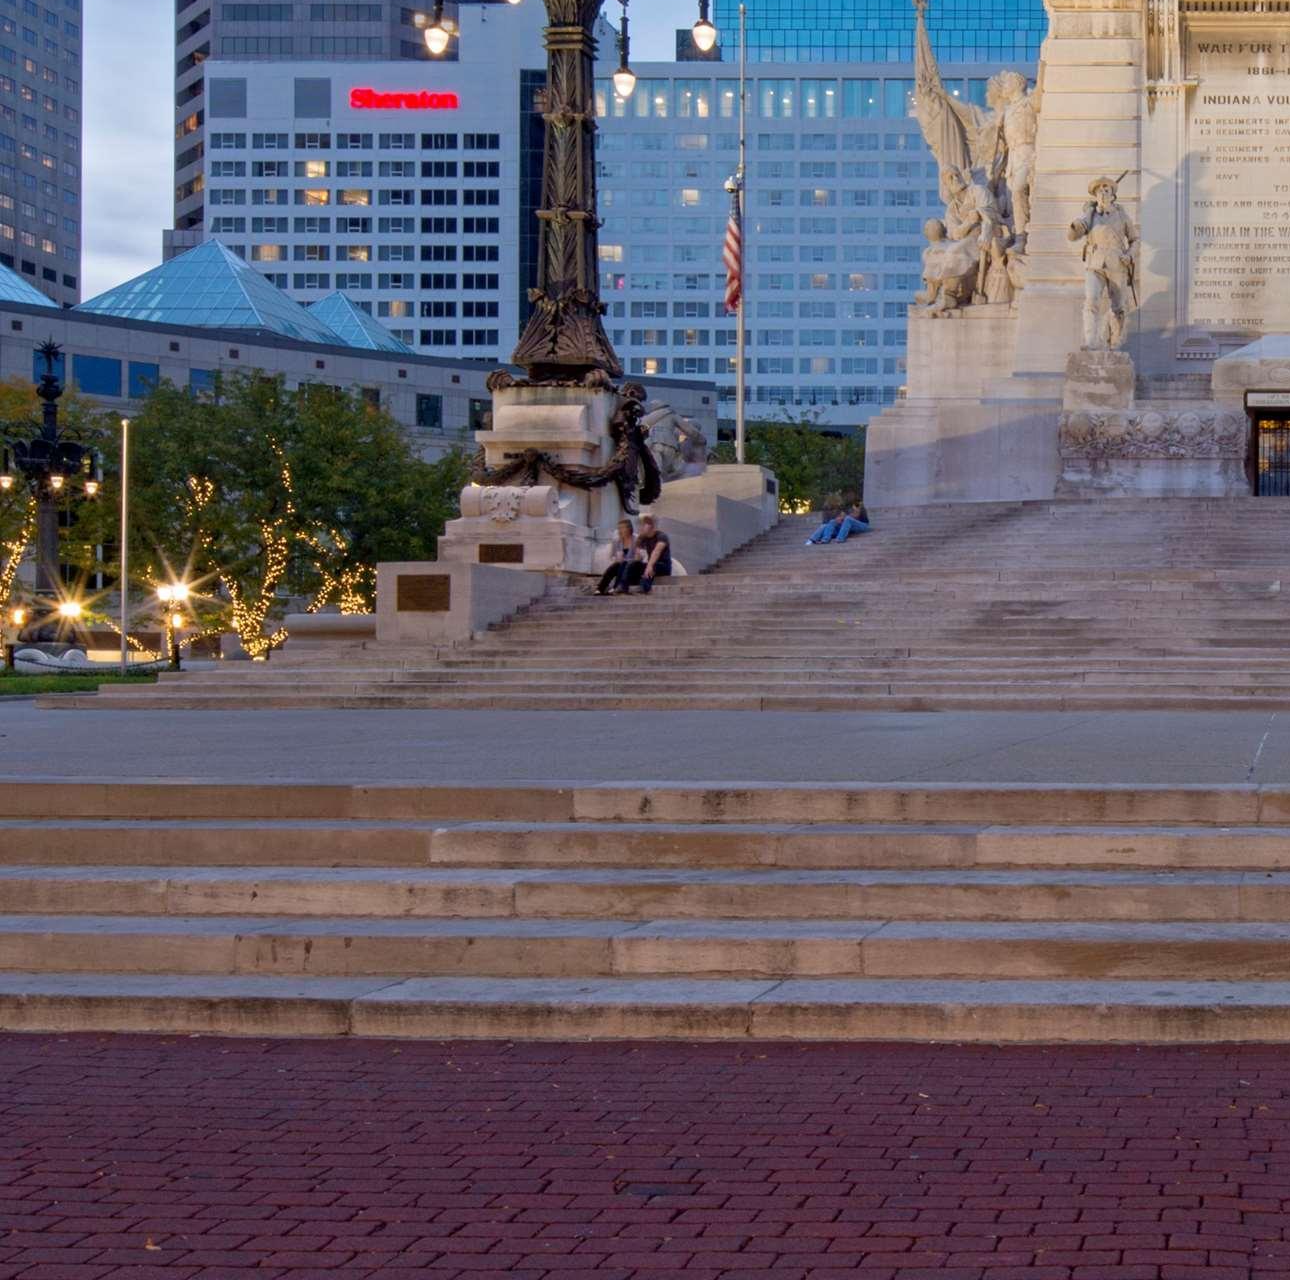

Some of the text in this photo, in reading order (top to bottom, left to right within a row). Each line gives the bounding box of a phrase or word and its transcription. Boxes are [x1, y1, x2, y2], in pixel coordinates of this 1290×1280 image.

[1198, 43, 1232, 54] WAR
[1239, 43, 1272, 54] FOR
[349, 88, 460, 110] Sheraton
[1203, 95, 1262, 105] INDIANA
[1215, 117, 1270, 125] REGIMENTS
[1215, 128, 1270, 136] REGIMENTS
[1215, 145, 1264, 153] REGIMENT
[1215, 156, 1270, 164] COMPANIES
[1215, 173, 1240, 181] NAVY
[1194, 226, 1236, 238] INDIANA
[1239, 226, 1250, 238] IN
[1254, 226, 1275, 238] THE
